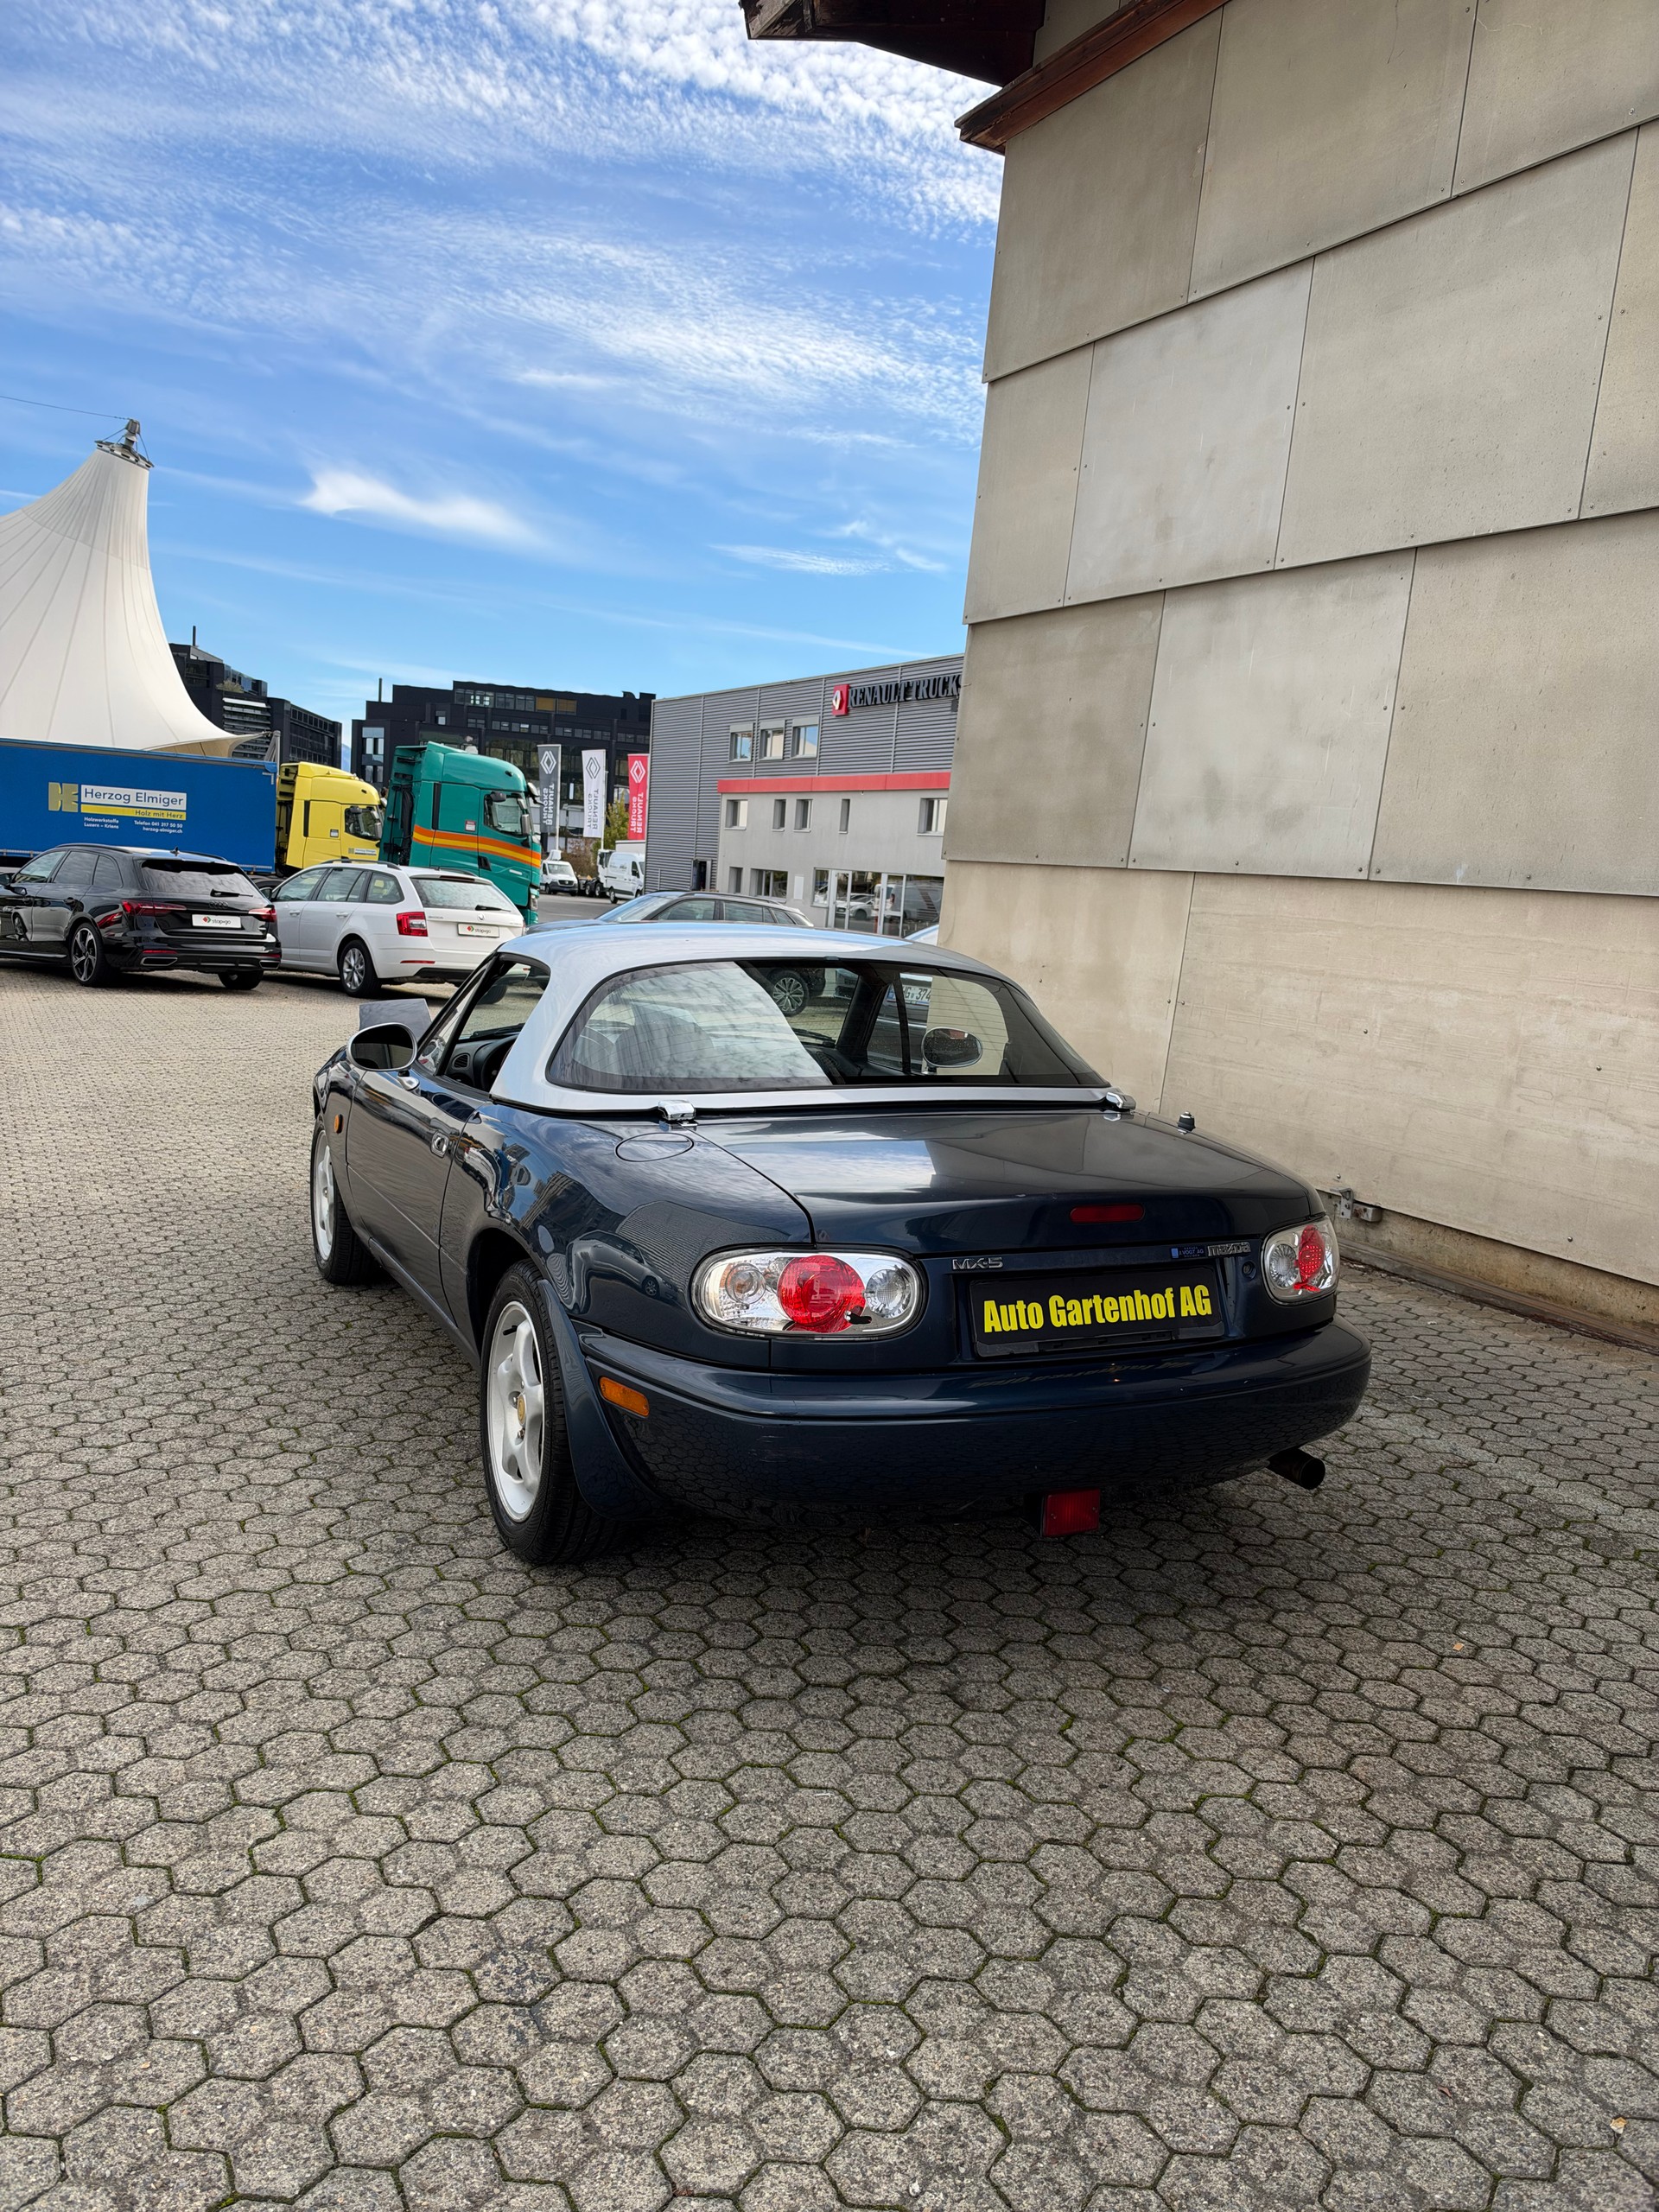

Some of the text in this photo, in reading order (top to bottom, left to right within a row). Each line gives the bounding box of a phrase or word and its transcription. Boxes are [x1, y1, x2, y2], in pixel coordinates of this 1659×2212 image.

[848, 682, 908, 708] RENAULT
[85, 788, 184, 806] Herzog Elmiger
[983, 1284, 1212, 1333] Auto Gartenhof AG
